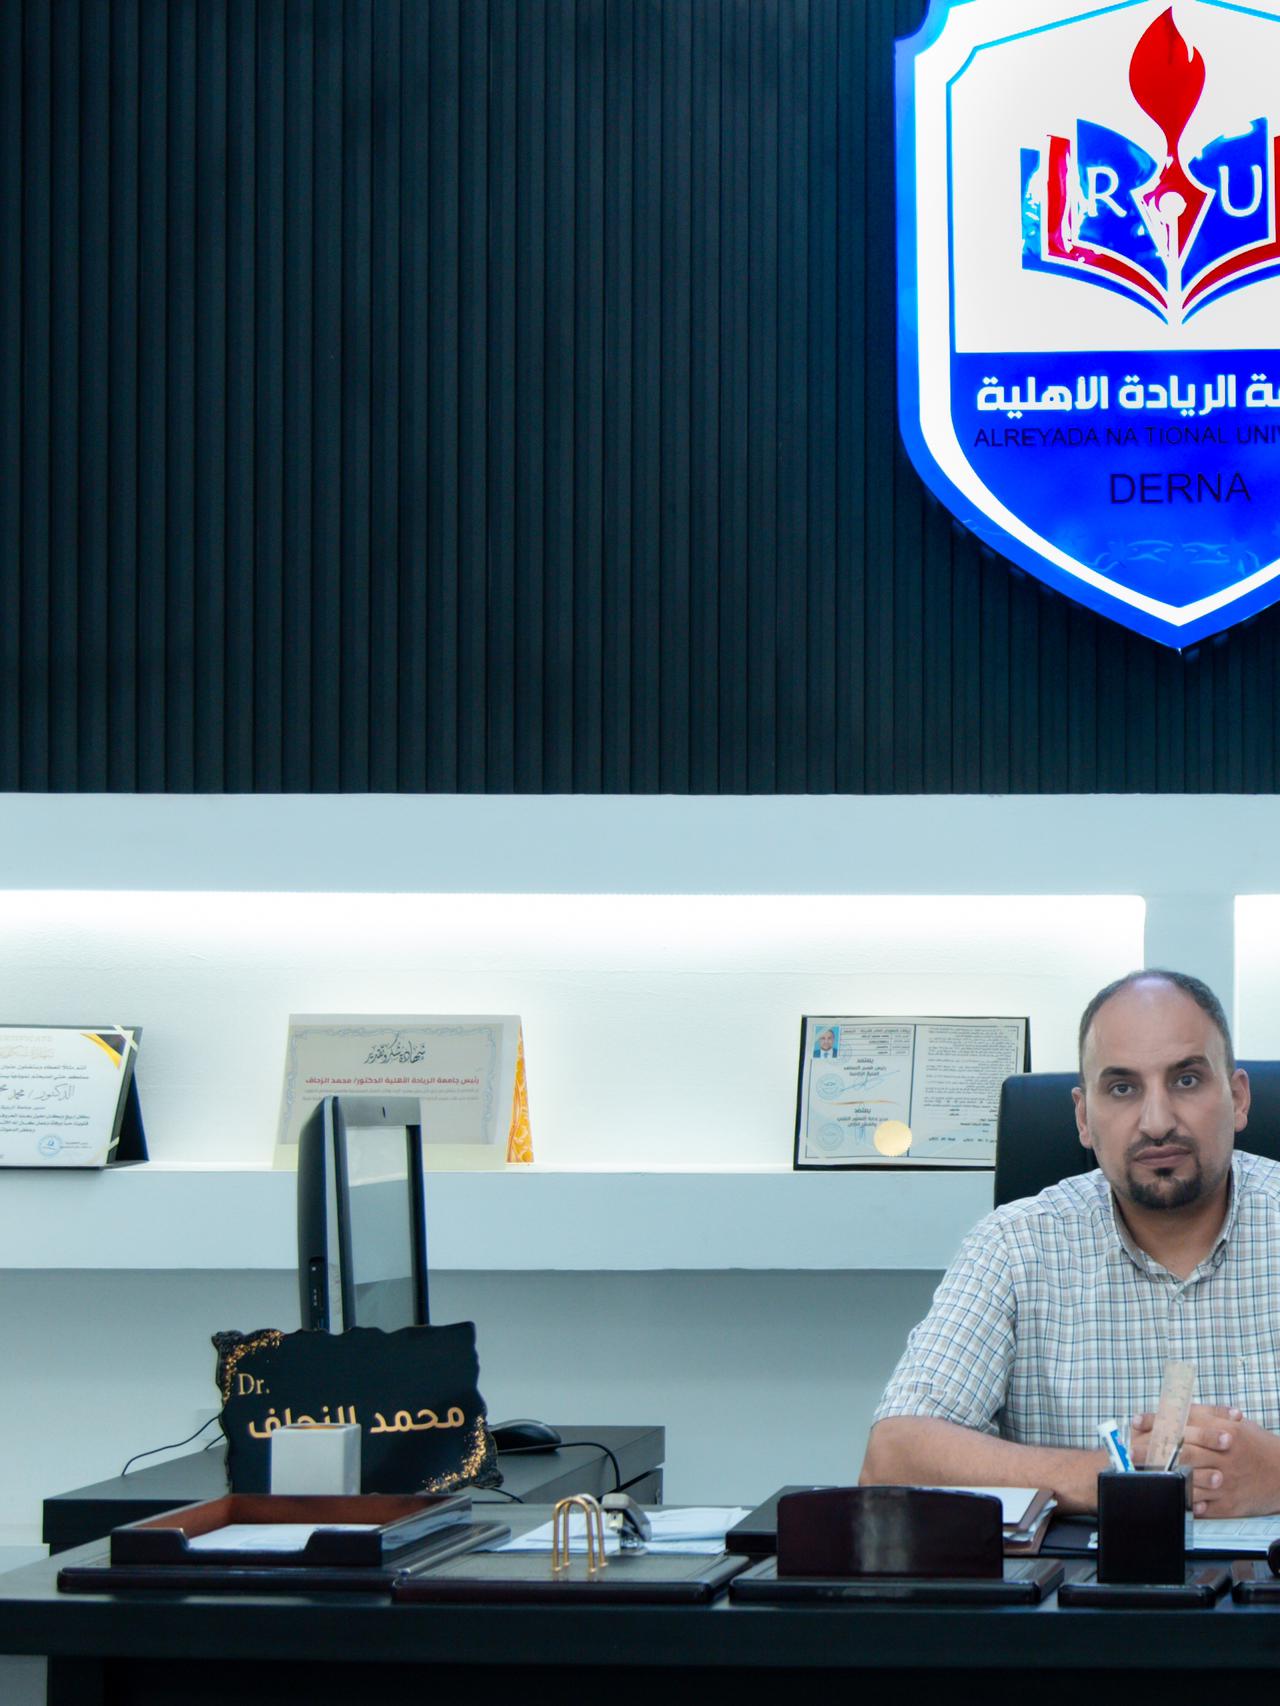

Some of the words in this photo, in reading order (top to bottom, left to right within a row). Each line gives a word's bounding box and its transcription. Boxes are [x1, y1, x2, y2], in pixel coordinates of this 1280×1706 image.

[1086, 166, 1127, 218] R
[1219, 165, 1263, 218] U
[977, 376, 1109, 419] الاهلية
[1119, 374, 1237, 416] الريادة
[974, 428, 1098, 447] ALREYADA
[1111, 472, 1251, 505] DERNA
[437, 1076, 460, 1085] جامعة
[238, 1373, 271, 1396] Dr.
[370, 1406, 465, 1435] محمد
